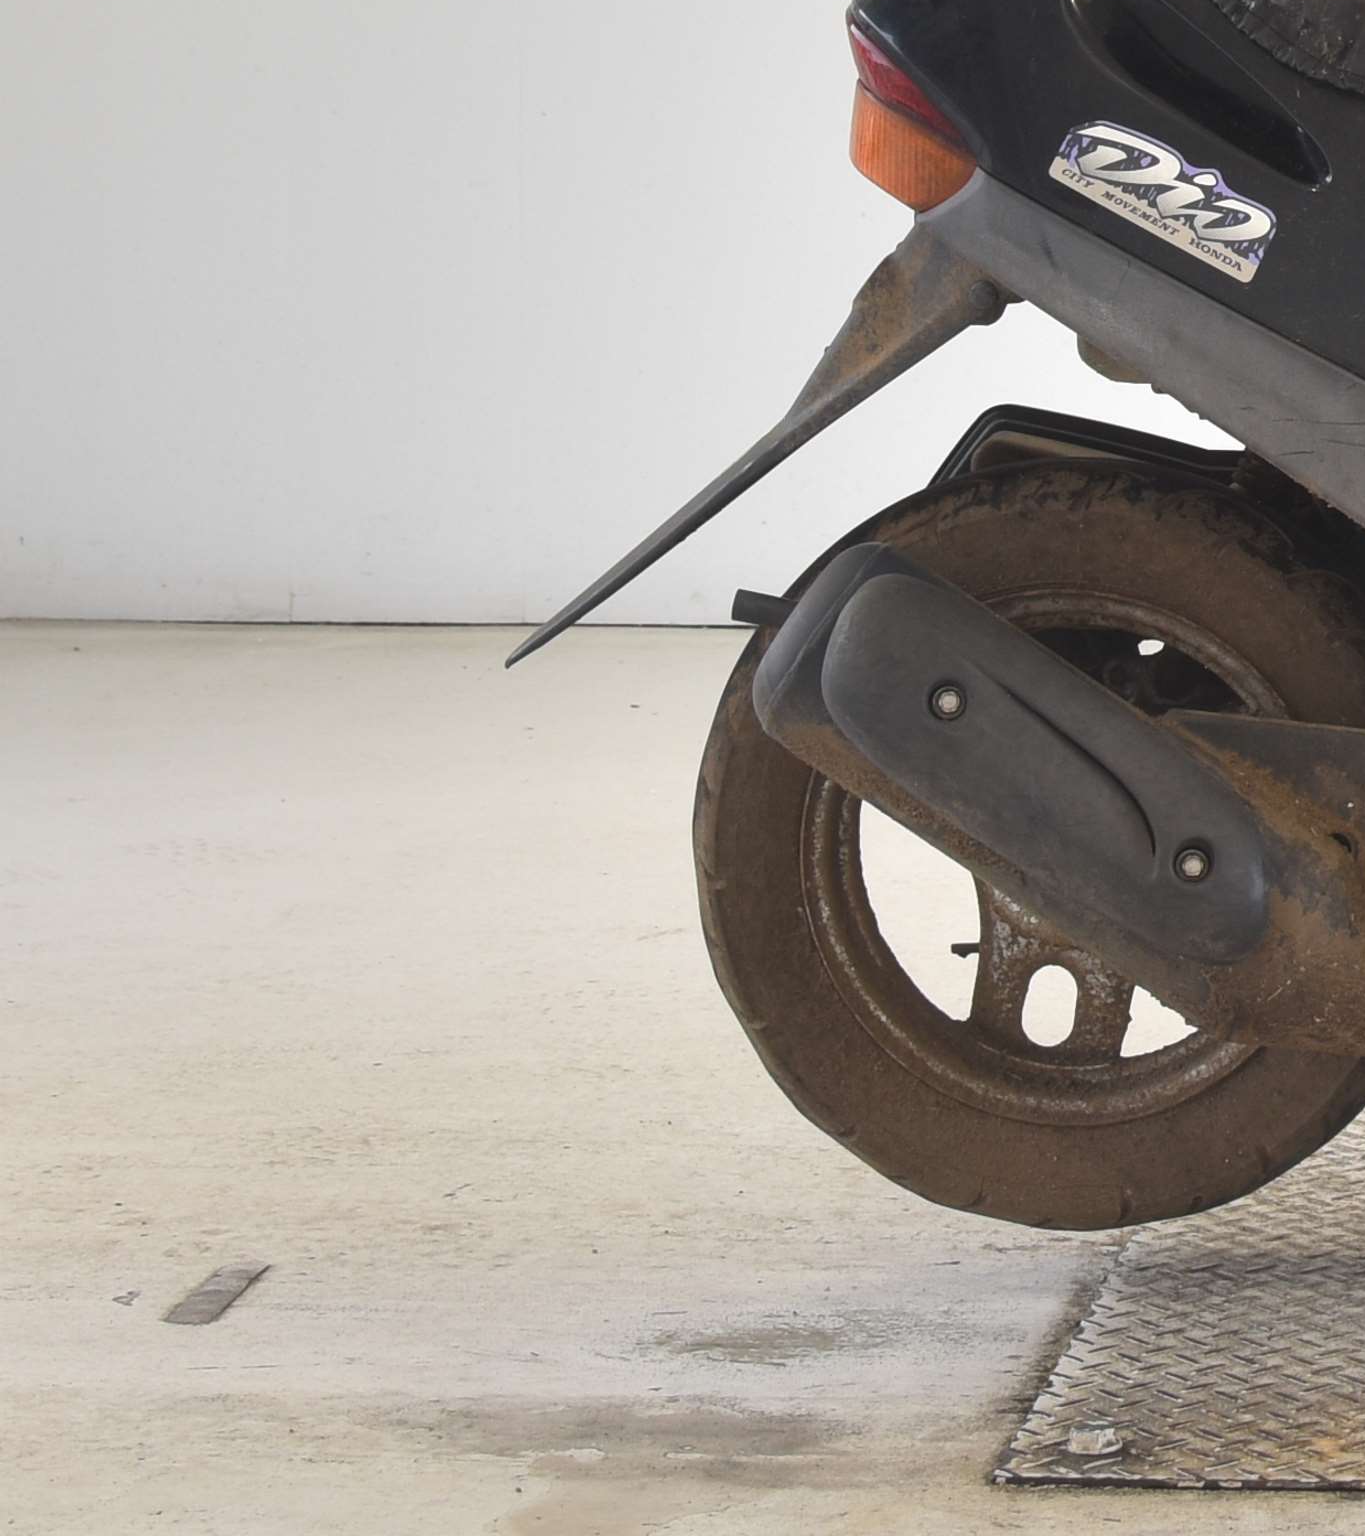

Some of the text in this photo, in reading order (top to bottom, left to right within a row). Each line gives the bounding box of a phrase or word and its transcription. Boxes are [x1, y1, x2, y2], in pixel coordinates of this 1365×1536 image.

[1061, 168, 1243, 272] CITY MOVEMENT HONDA
